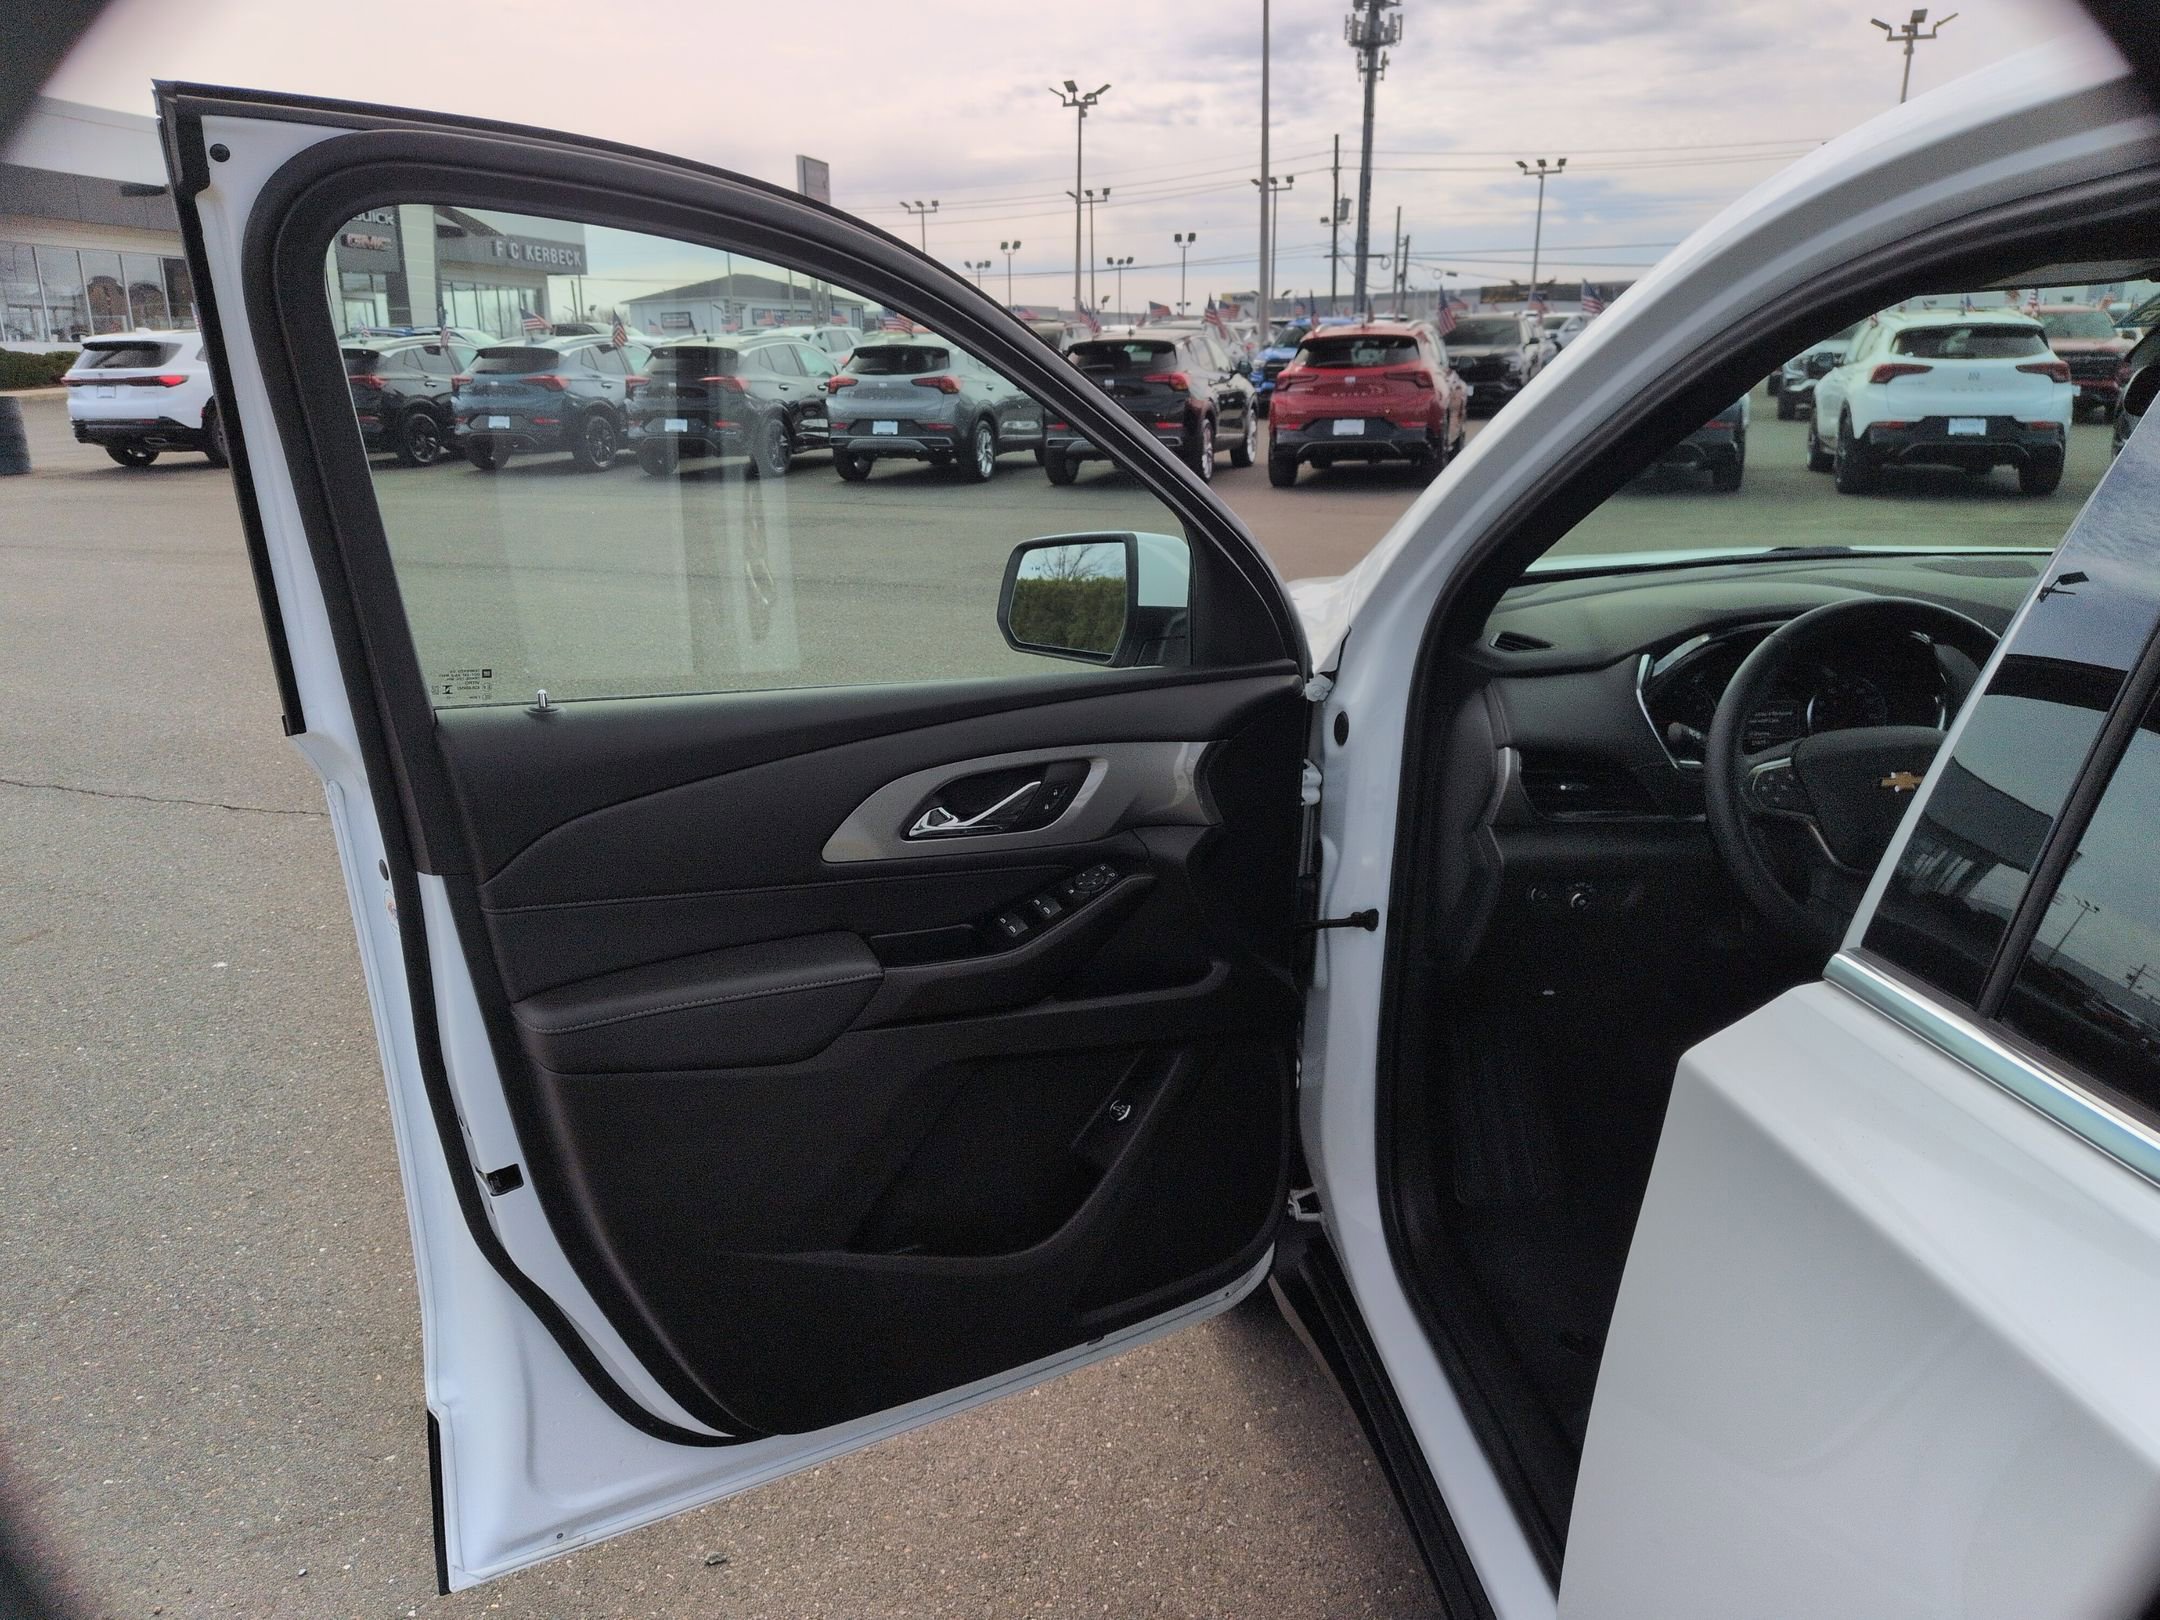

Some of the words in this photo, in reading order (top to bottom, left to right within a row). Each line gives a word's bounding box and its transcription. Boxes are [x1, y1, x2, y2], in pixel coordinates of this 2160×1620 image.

[495, 240, 503, 257] F
[510, 242, 519, 259] C
[526, 244, 582, 267] KERBECK
